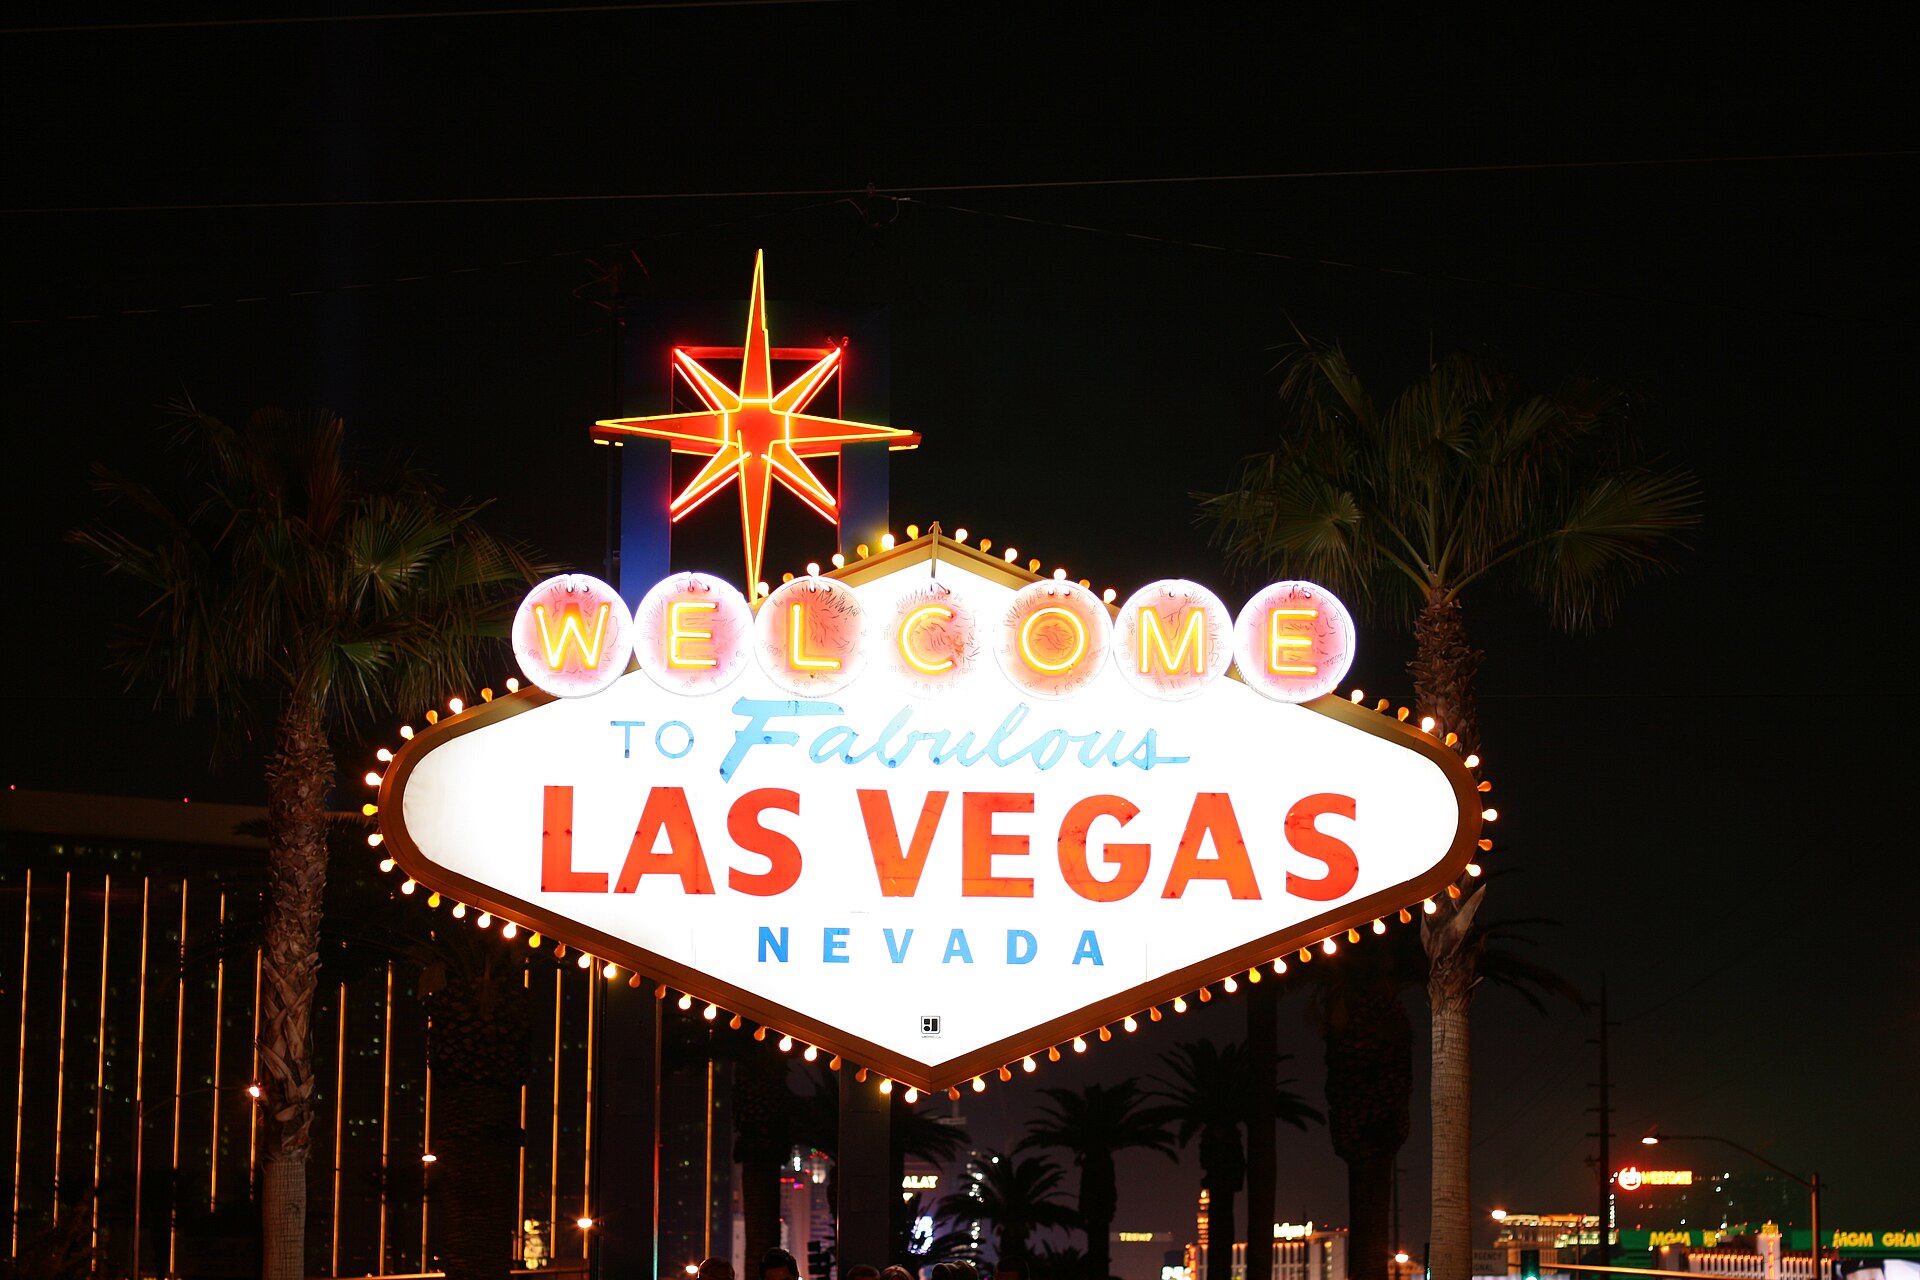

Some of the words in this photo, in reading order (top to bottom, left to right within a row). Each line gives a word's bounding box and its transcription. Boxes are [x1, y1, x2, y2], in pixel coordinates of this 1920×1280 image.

[533, 600, 1320, 677] WELCOME
[610, 720, 695, 758] TO
[719, 696, 1190, 784] Fabulous
[541, 785, 803, 897] LAS
[856, 789, 1360, 903] VEGAS
[757, 926, 1105, 966] NEVADA
[1649, 1231, 1691, 1247] MGM
[1831, 1231, 1874, 1248] MGM
